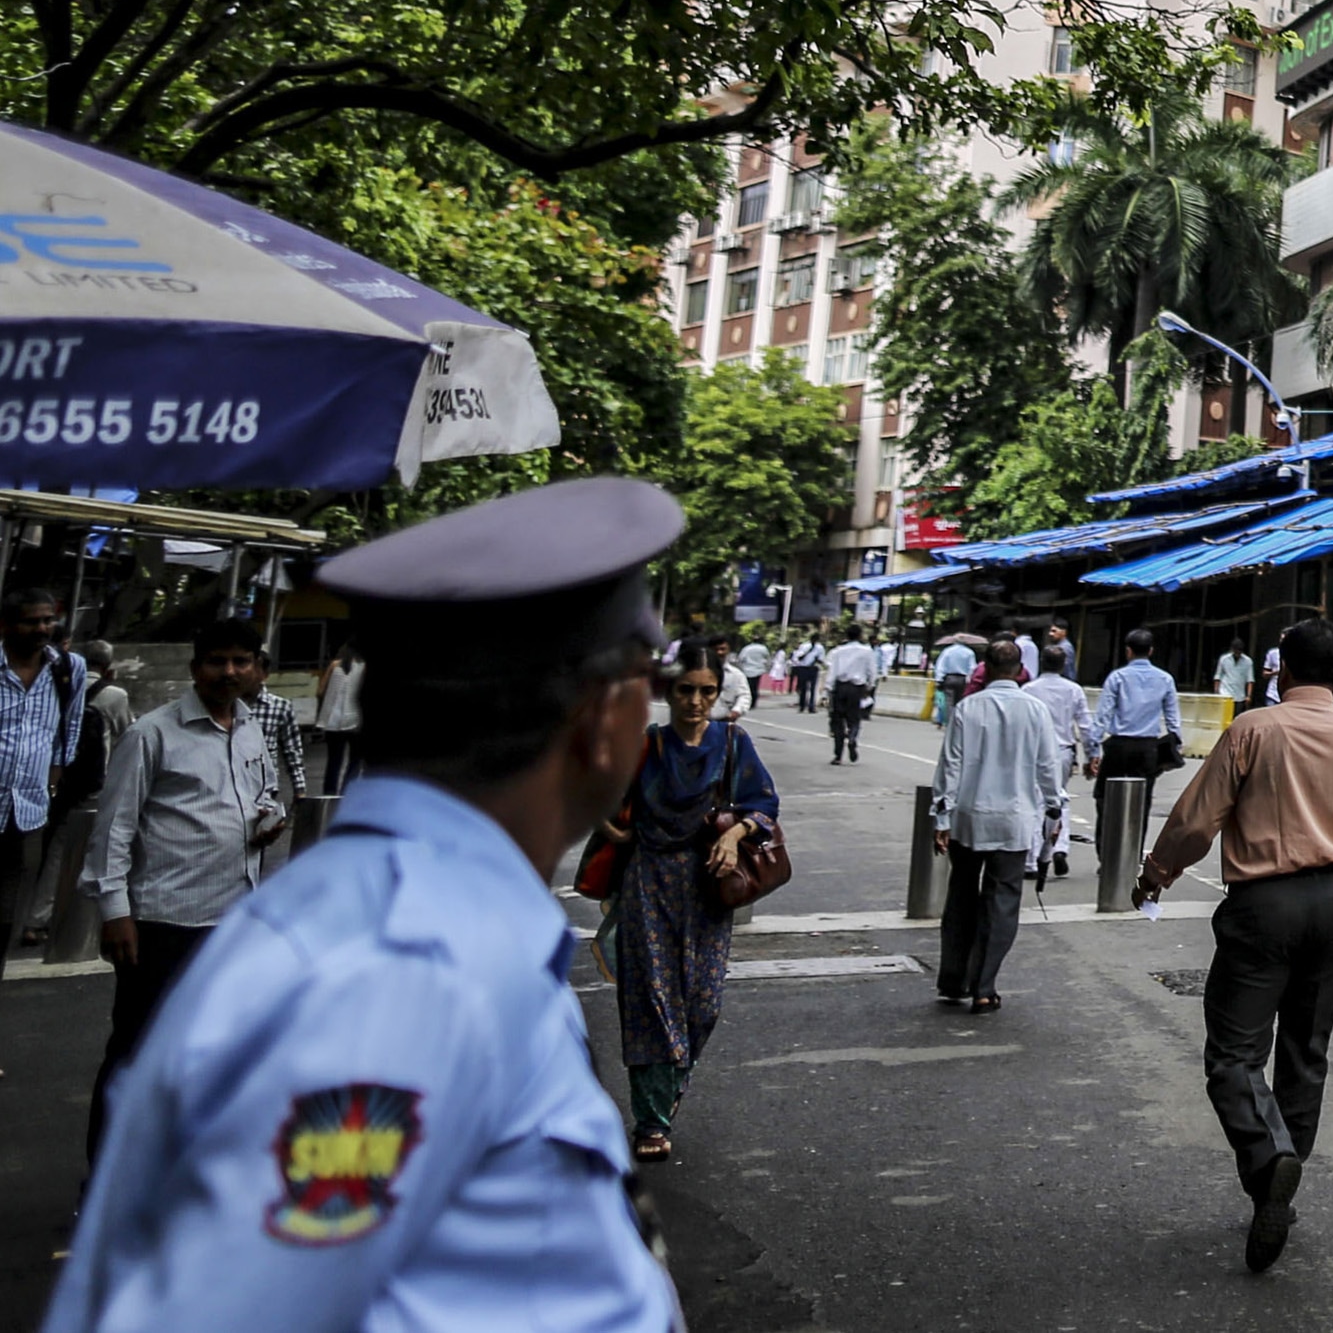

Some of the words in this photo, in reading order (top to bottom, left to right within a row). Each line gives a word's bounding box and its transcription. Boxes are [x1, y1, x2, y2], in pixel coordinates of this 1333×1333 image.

[1306, 21, 1319, 57] of
[24, 270, 198, 294] LIMITED
[0, 399, 133, 444] 6555
[146, 401, 260, 444] 5148
